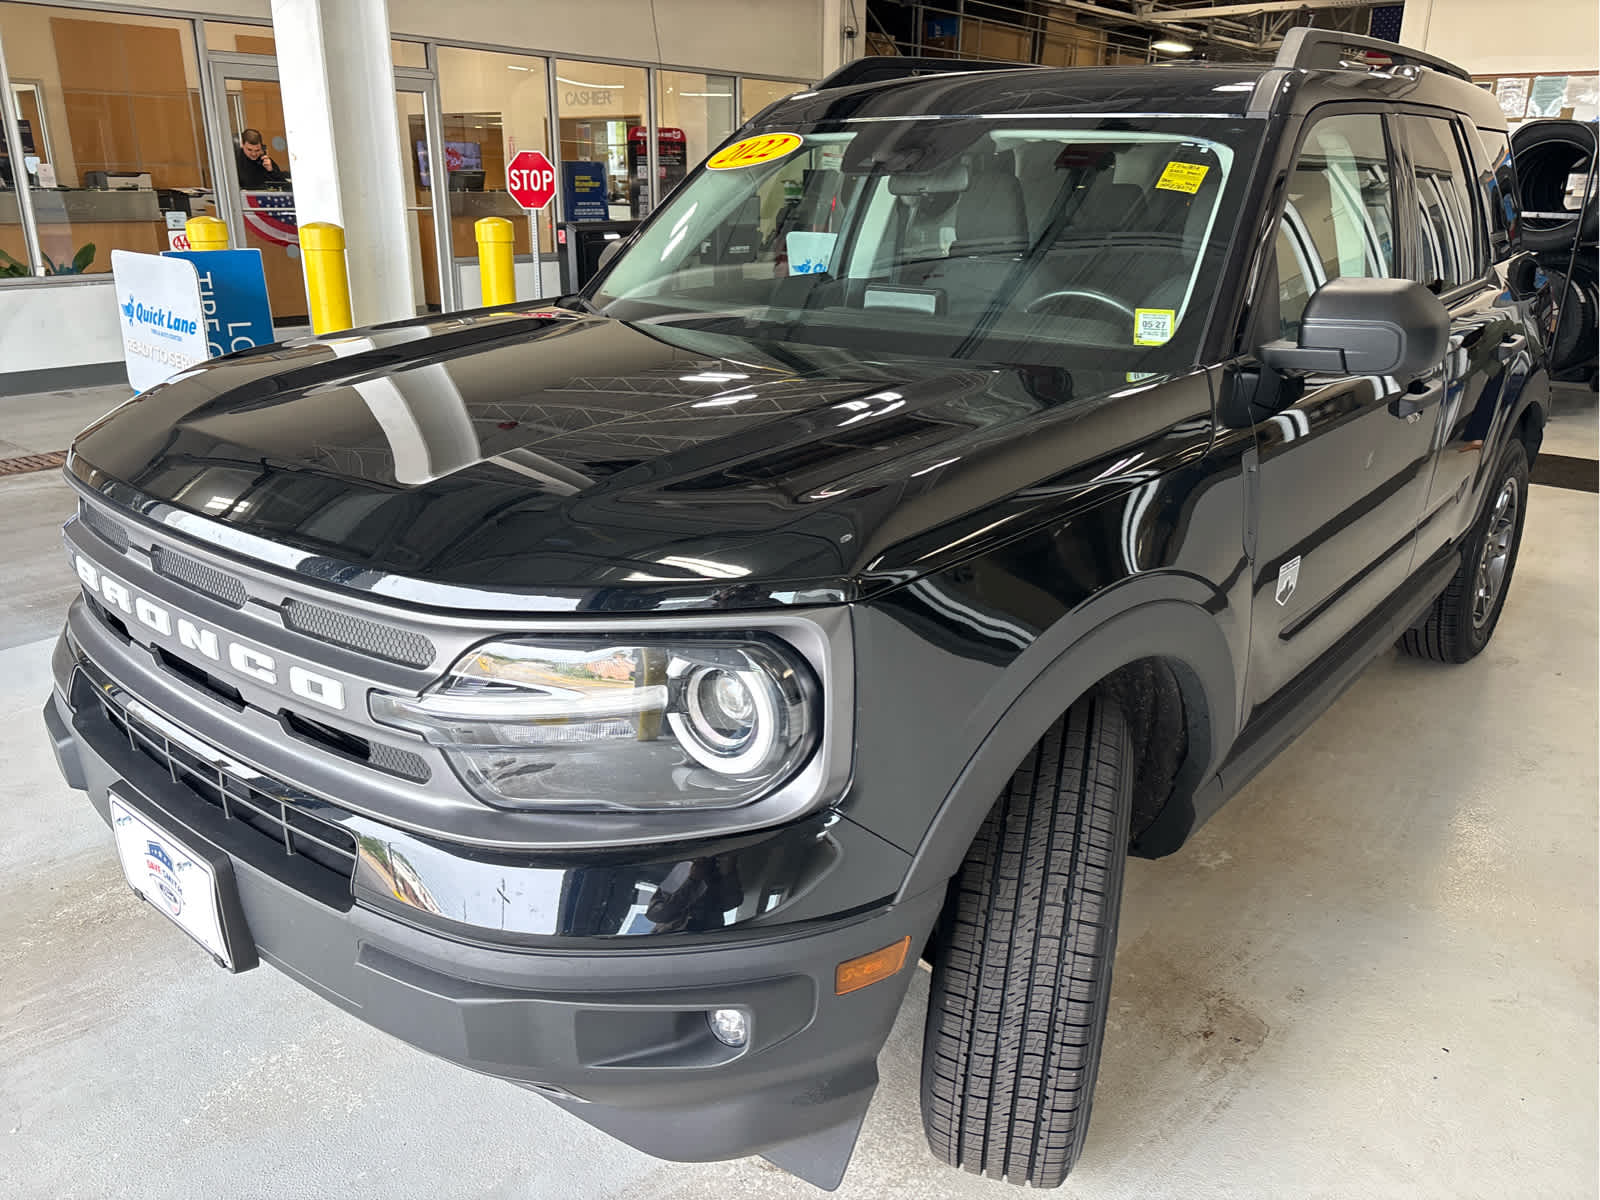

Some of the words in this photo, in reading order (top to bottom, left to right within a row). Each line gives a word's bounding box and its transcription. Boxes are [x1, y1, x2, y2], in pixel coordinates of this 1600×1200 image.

[565, 91, 612, 105] CASHIER
[715, 137, 791, 165] 2022
[510, 169, 553, 192] STOP
[136, 302, 164, 327] Quick
[167, 311, 197, 335] Lane
[75, 555, 345, 710] BRONCO
